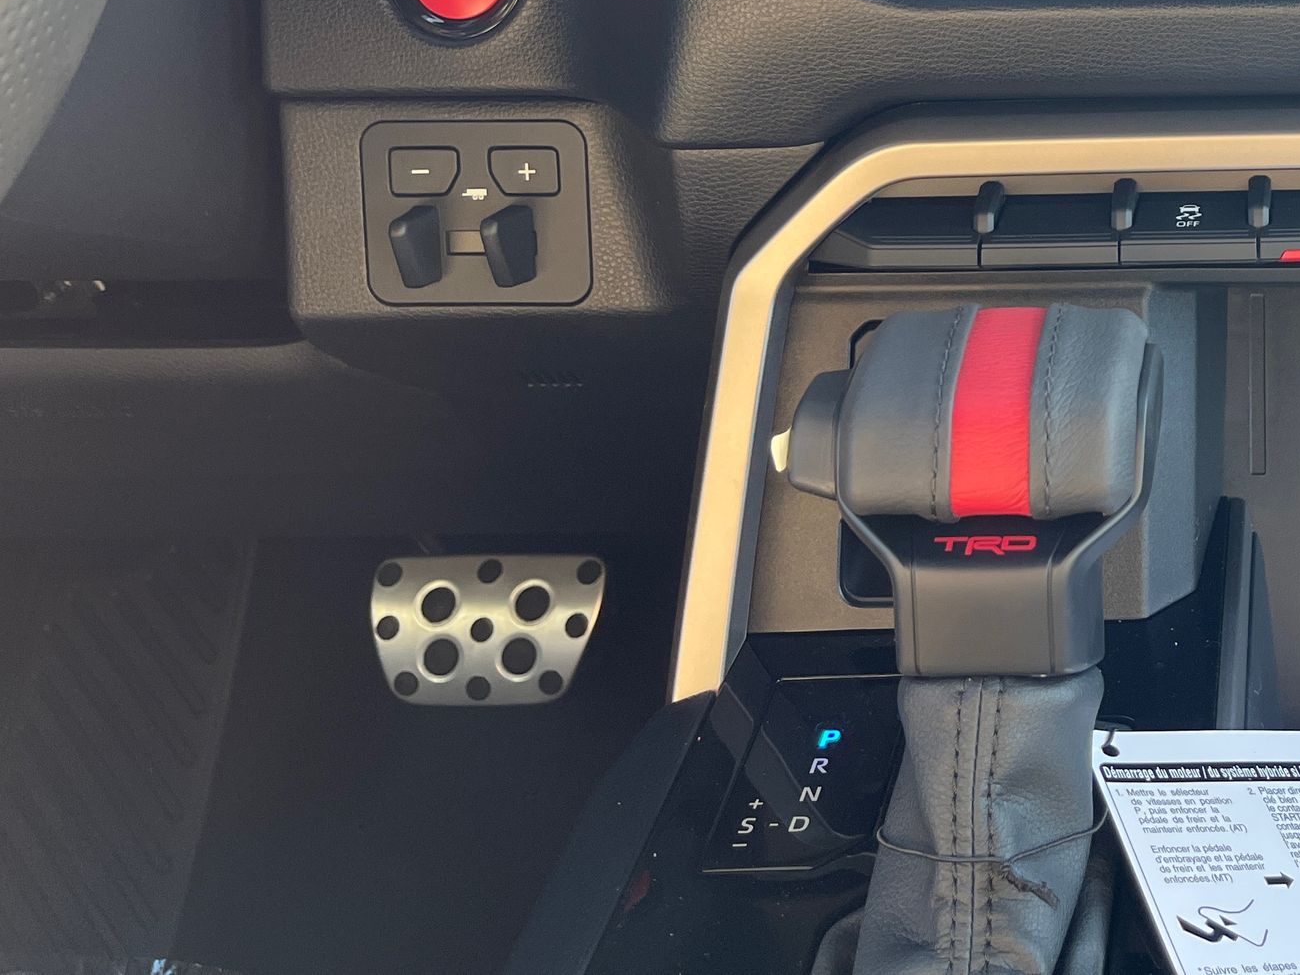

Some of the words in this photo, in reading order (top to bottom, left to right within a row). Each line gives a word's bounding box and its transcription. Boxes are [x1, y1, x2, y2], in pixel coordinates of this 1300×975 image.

[1176, 220, 1200, 228] OFF
[934, 535, 1038, 556] TRD
[817, 729, 842, 750] P
[809, 757, 829, 775] R
[1102, 766, 1155, 782] Démarrage
[1155, 766, 1169, 779] du
[1168, 767, 1201, 779] moteur
[1201, 766, 1208, 779] /
[1207, 766, 1221, 779] du
[1220, 766, 1257, 780] système
[1256, 765, 1291, 780] hybride
[1290, 765, 1300, 777] si
[799, 786, 822, 803] N
[737, 817, 757, 834] S
[788, 816, 810, 833] D
